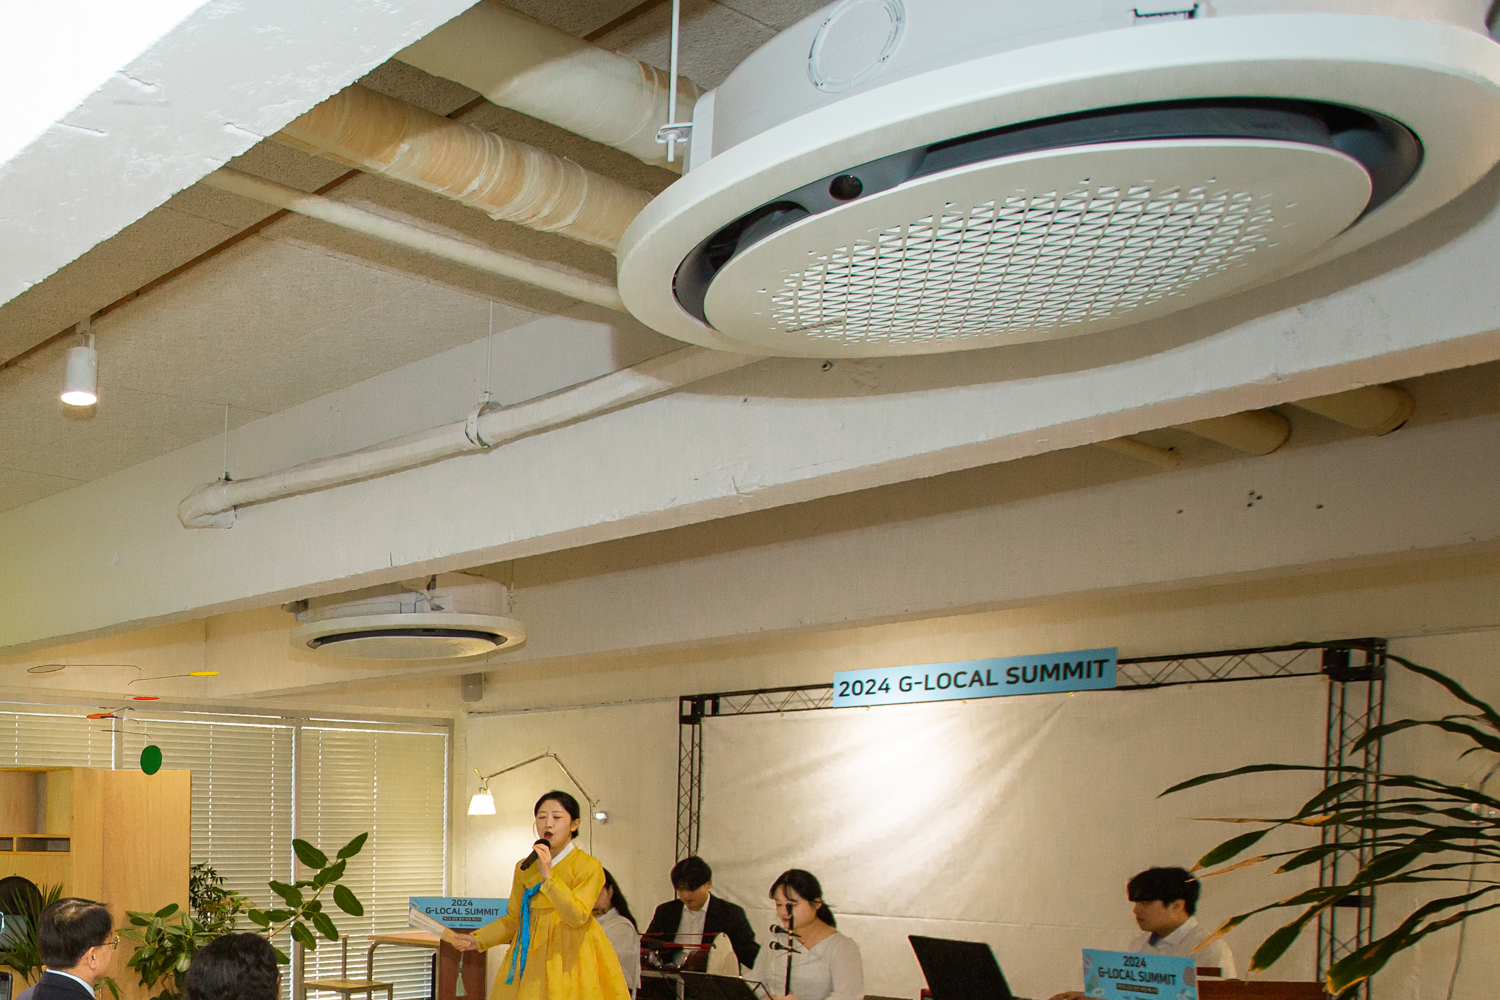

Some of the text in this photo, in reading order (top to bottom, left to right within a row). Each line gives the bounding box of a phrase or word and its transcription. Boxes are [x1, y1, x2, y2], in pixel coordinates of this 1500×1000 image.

[839, 659, 1110, 697] 2024 G-LOCAL SUMMIT
[451, 899, 473, 907] 2024
[425, 907, 499, 916] G-LOCAL SUMMIT
[1123, 955, 1147, 968] 2024
[1098, 967, 1177, 986] G-LOCAL SUMMIT
